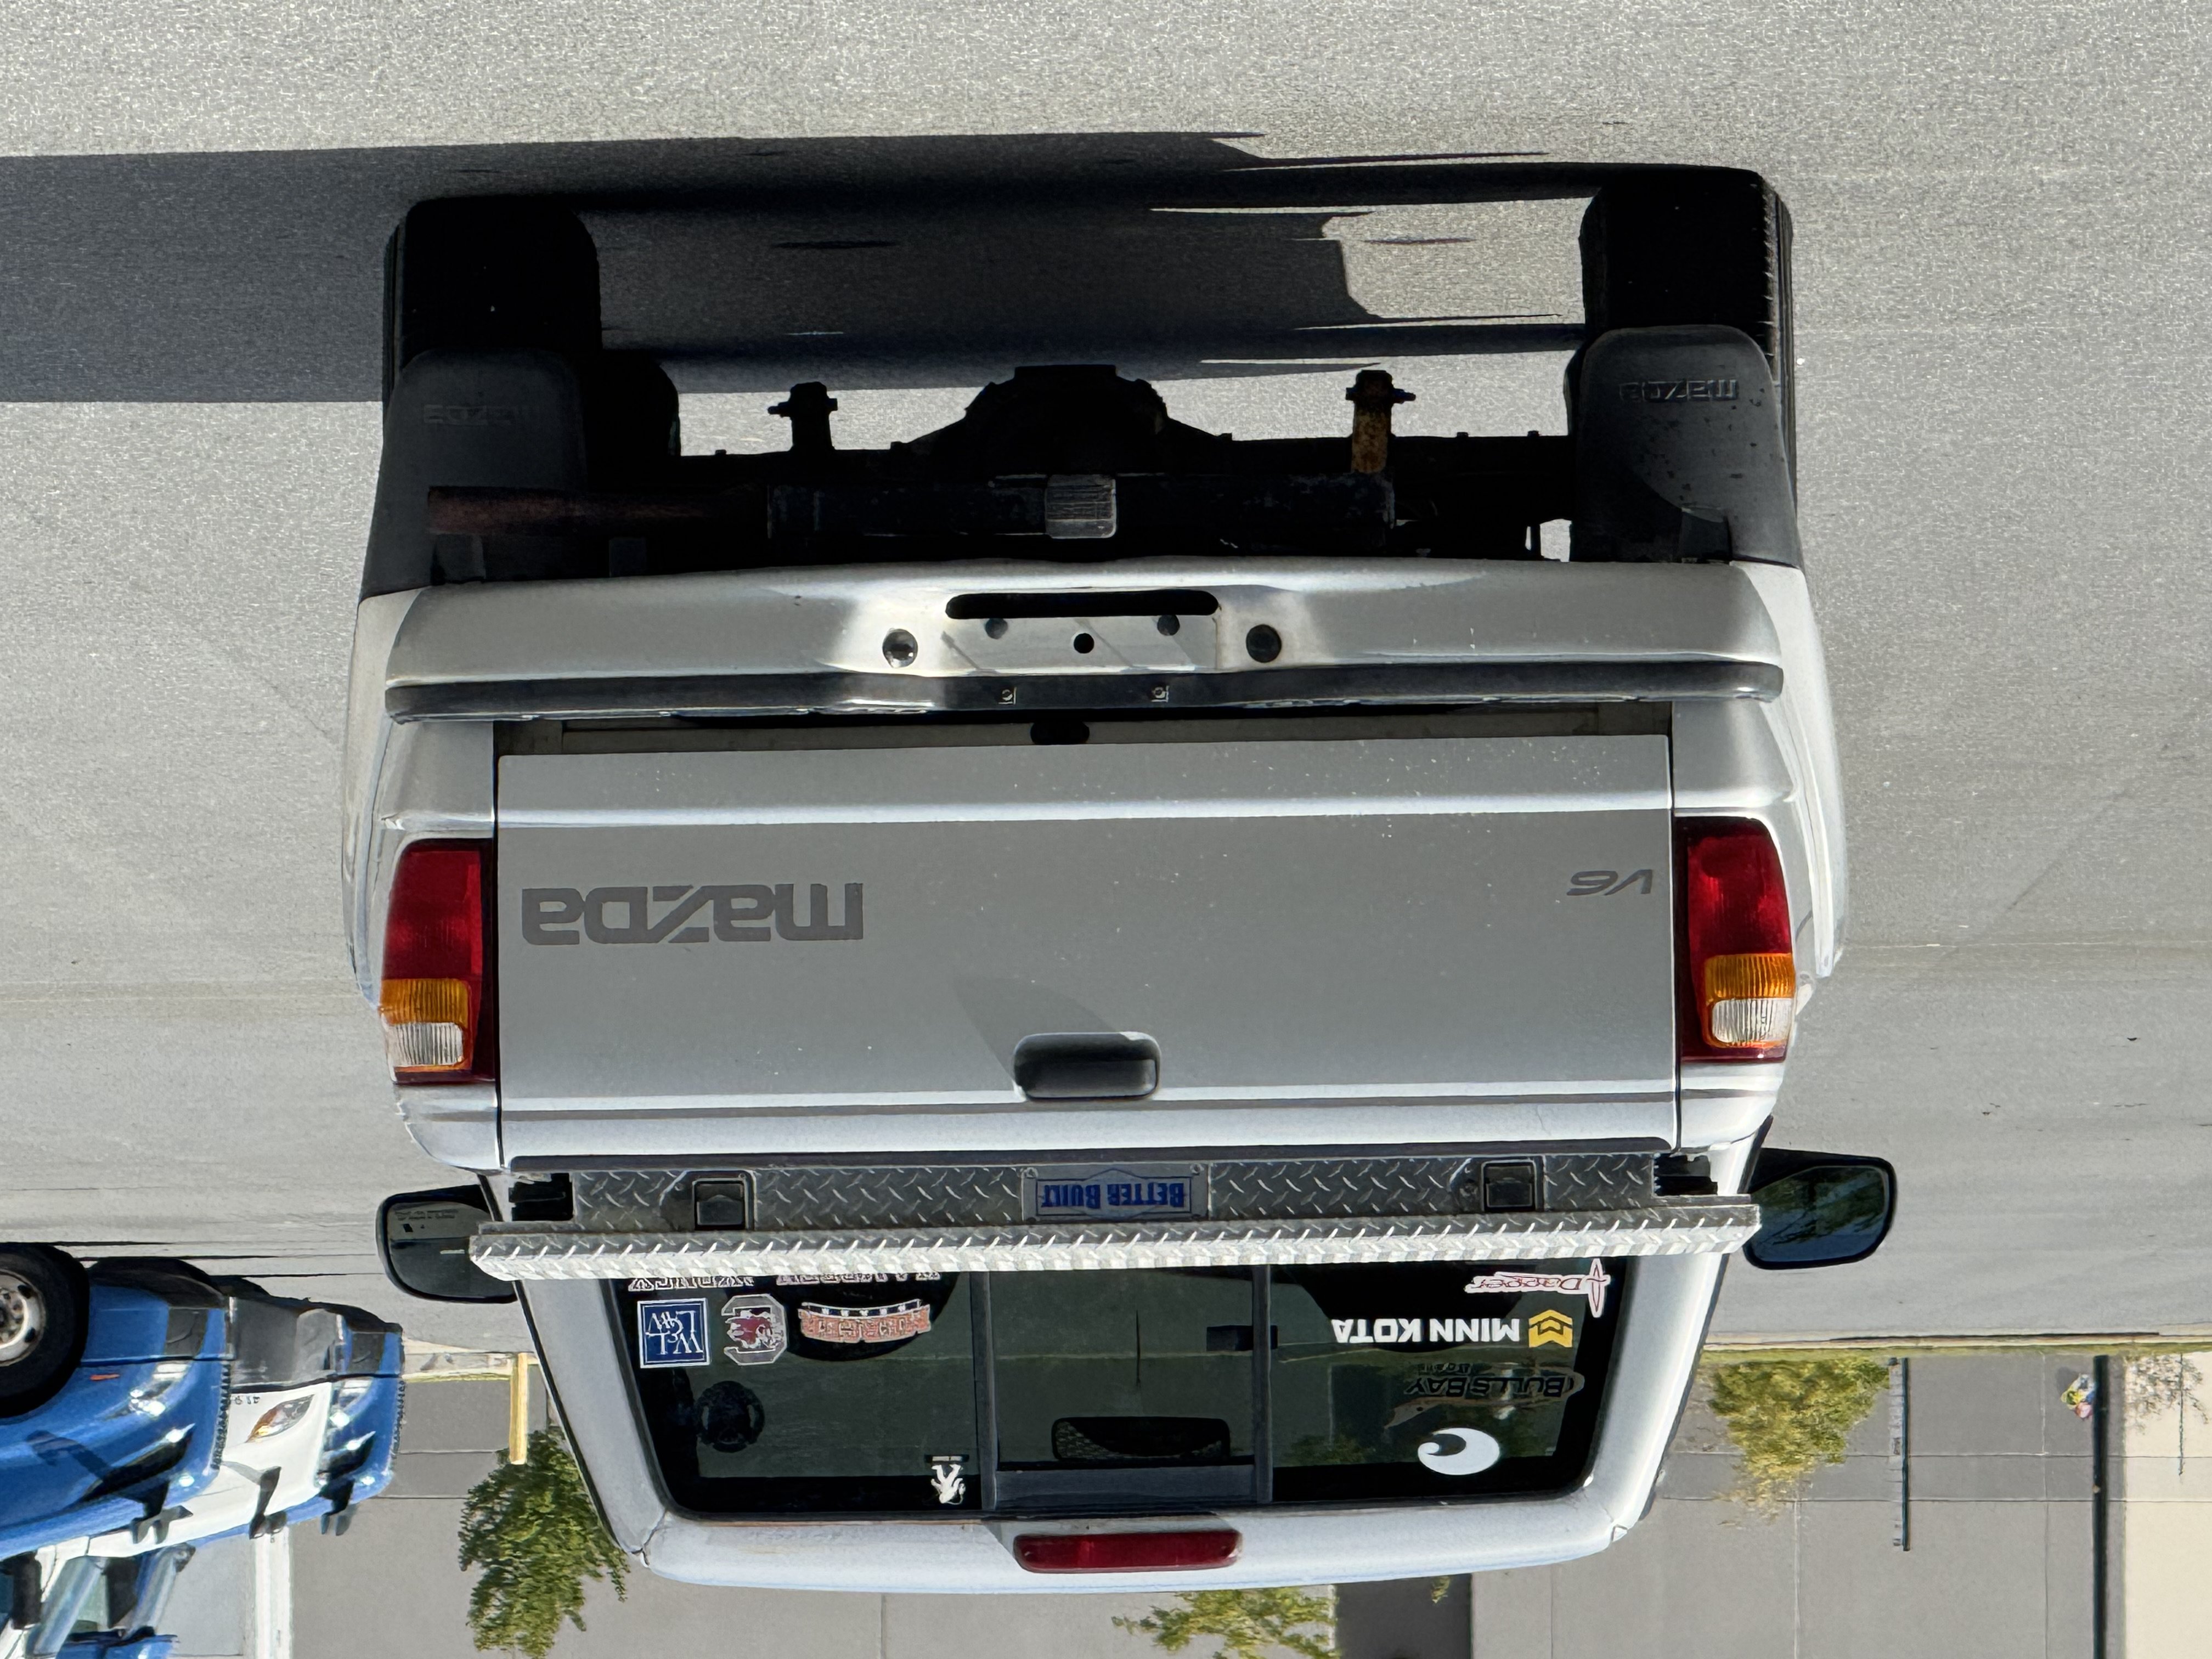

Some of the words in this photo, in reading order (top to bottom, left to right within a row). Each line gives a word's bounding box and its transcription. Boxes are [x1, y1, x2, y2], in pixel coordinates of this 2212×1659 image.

[1566, 869, 1653, 896] V6
[1040, 1184, 1101, 1210] BUILT
[1107, 1183, 1184, 1208] BETTER
[1330, 1318, 1421, 1344] KOTA
[1429, 1318, 1520, 1342] MINN
[1406, 1378, 1468, 1397] BAY
